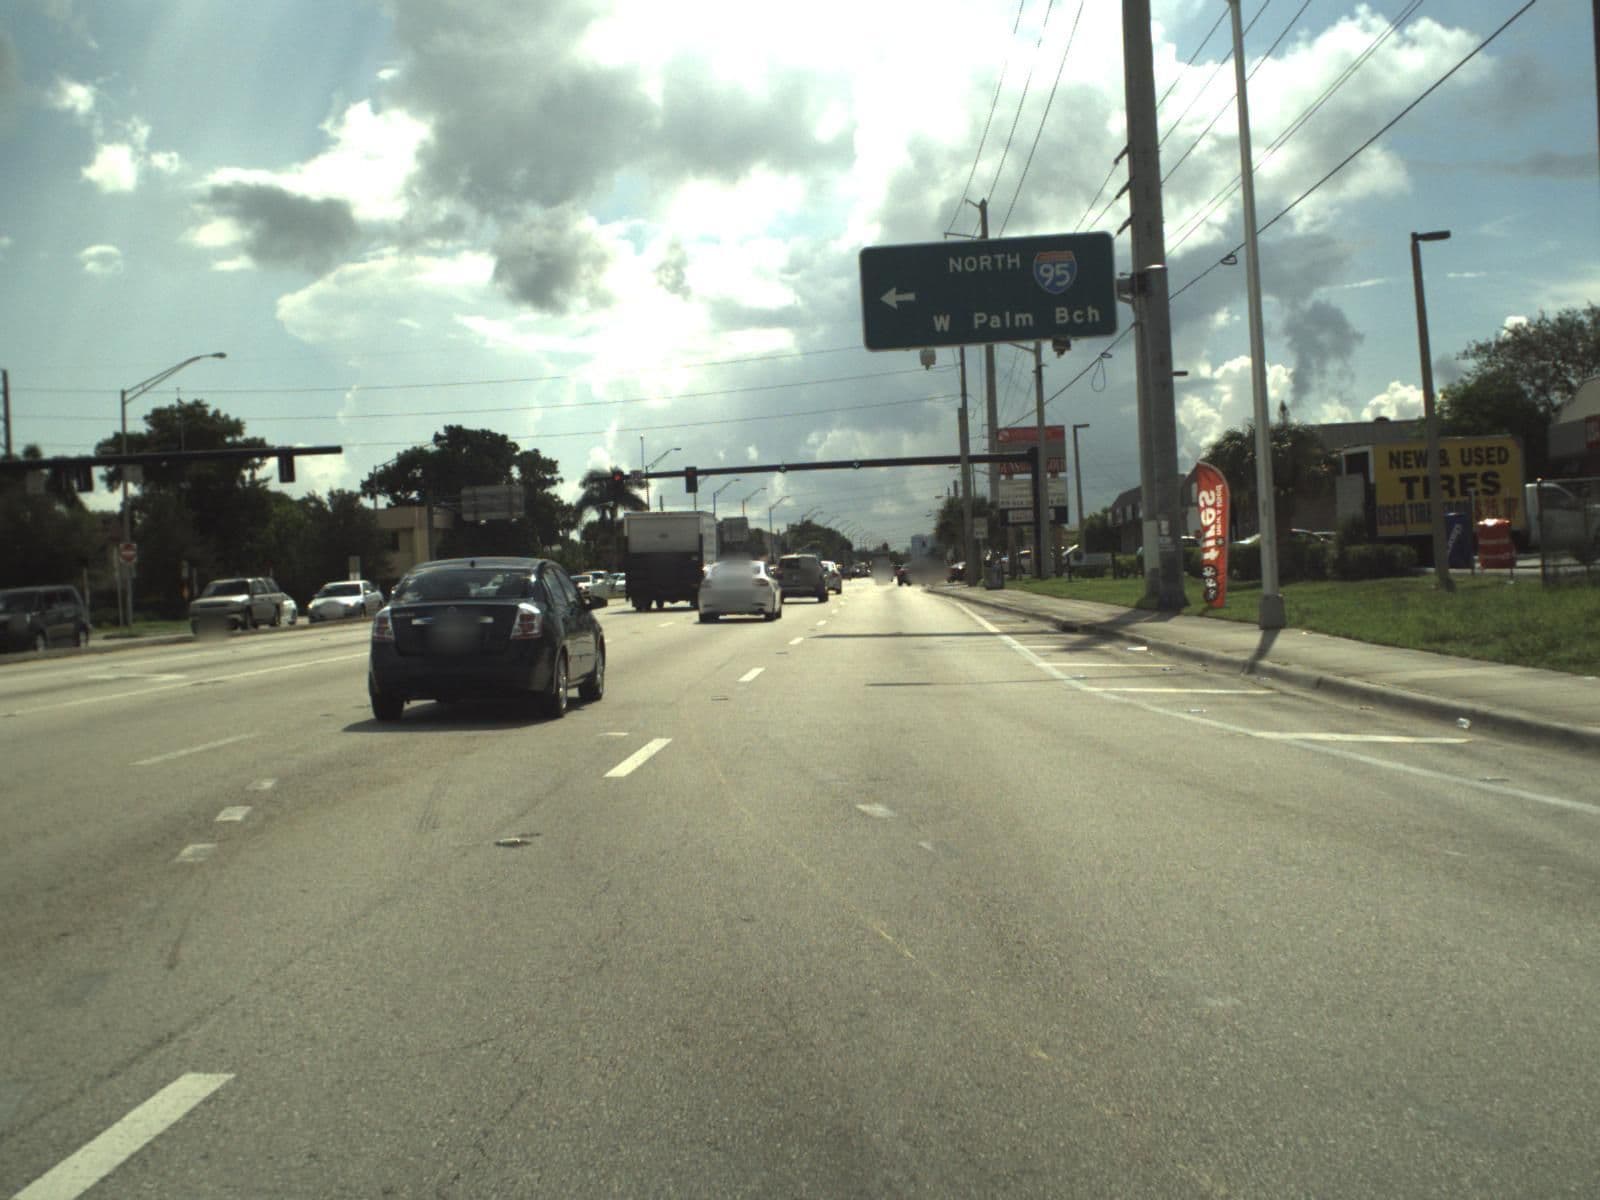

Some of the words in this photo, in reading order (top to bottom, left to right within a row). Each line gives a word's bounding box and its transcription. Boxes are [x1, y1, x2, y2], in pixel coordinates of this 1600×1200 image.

[948, 253, 1021, 273] NORTH
[1038, 263, 1071, 287] 95
[933, 314, 951, 332] W
[973, 311, 1034, 329] Palm
[1055, 306, 1100, 324] Bch
[1389, 448, 1428, 469] NEW
[1460, 446, 1509, 467] USED
[1400, 471, 1501, 500] TIRES
